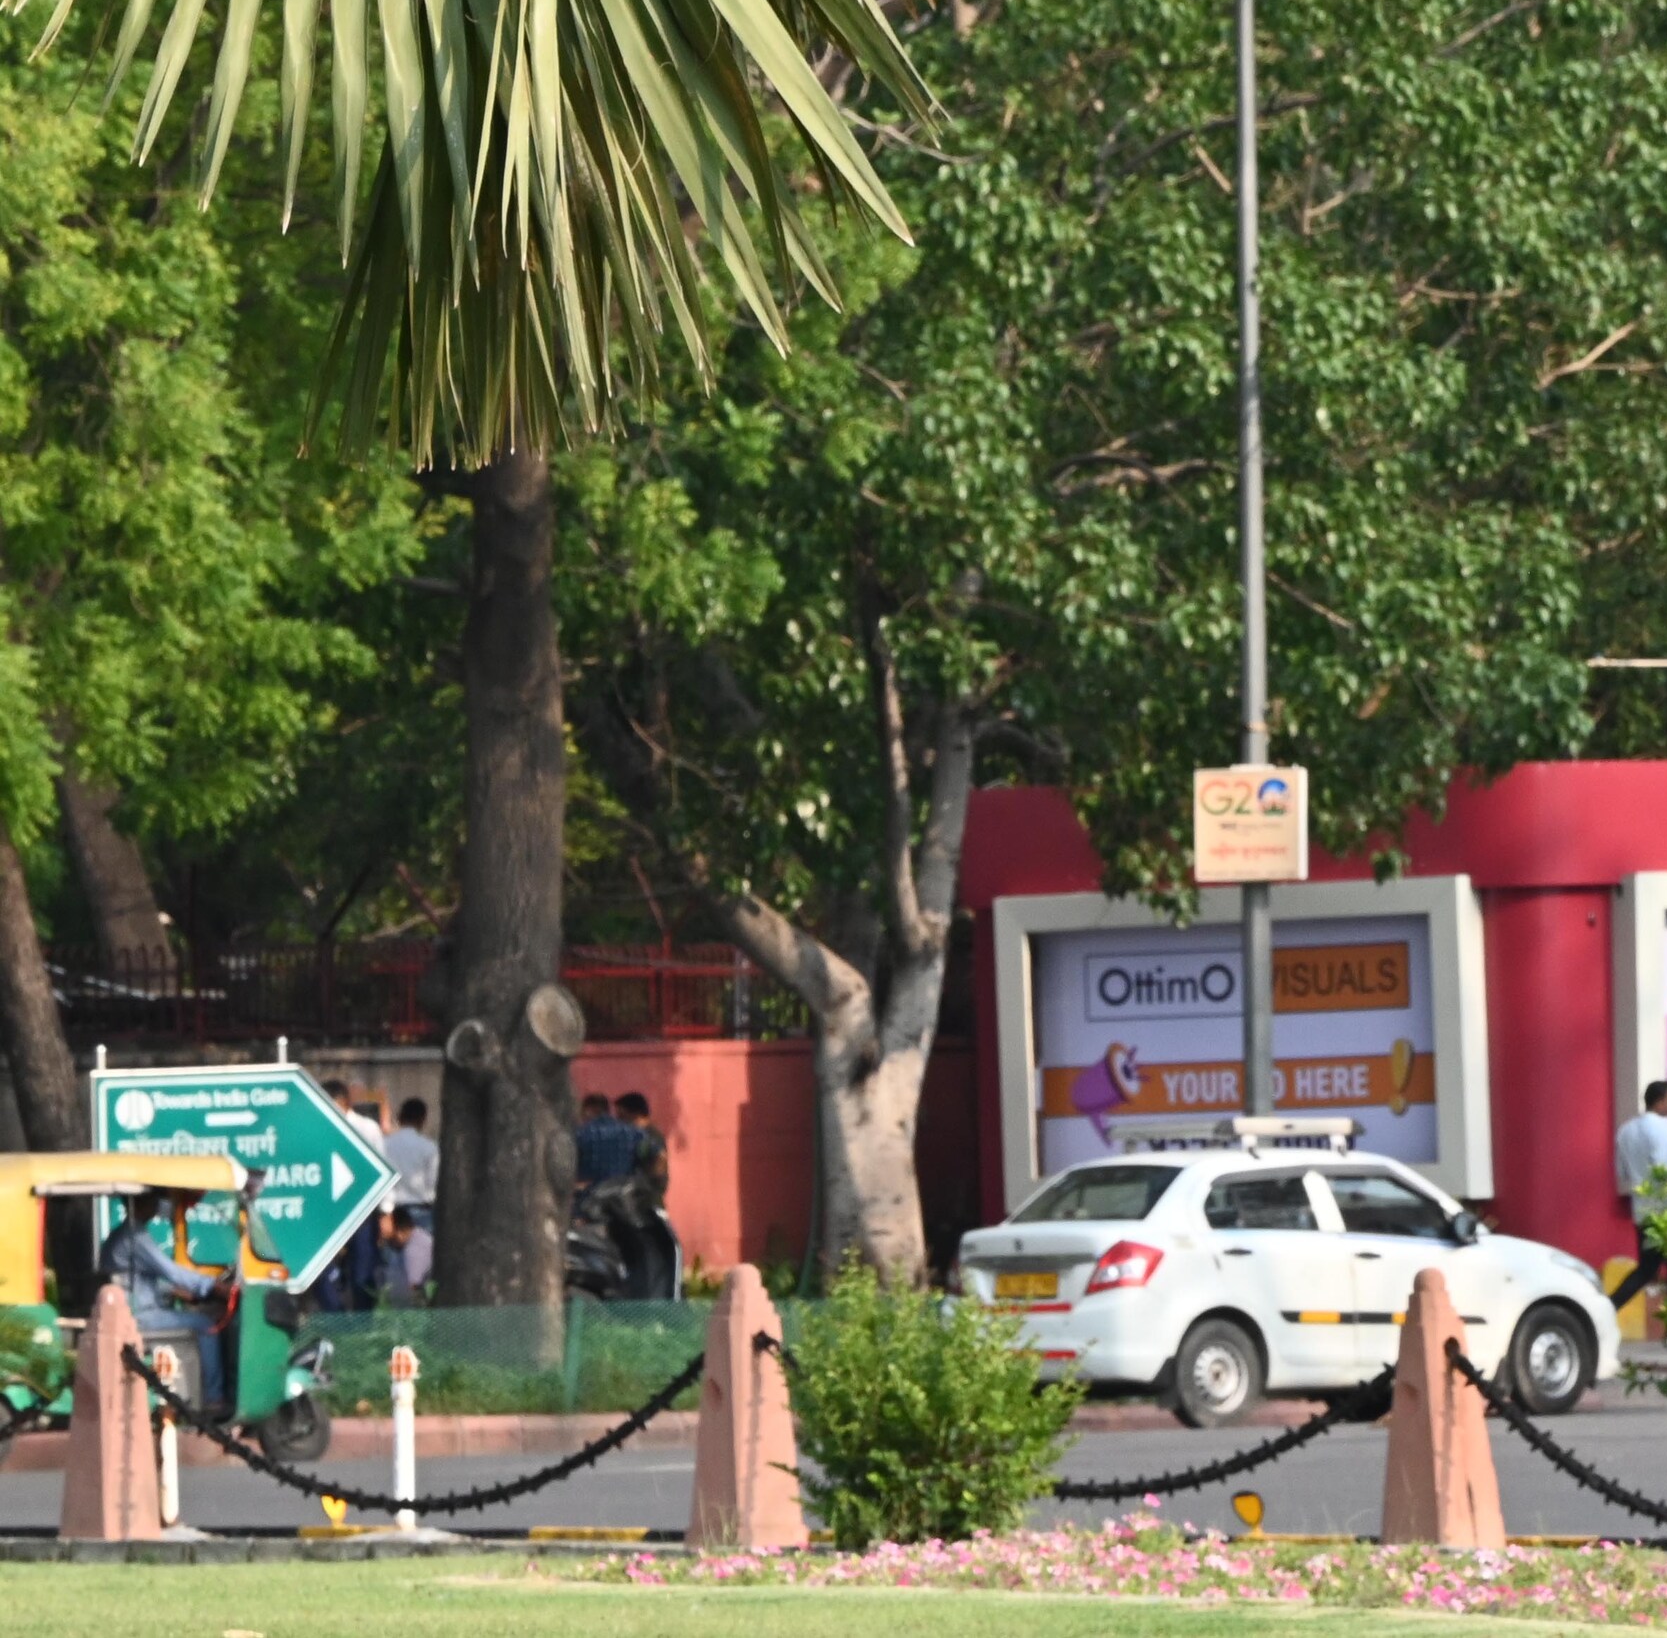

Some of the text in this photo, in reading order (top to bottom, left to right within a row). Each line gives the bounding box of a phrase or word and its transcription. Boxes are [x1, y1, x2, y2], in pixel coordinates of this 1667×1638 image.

[1098, 963, 1236, 1007] OttimO
[213, 1088, 249, 1108] India
[250, 1087, 289, 1106] Gate
[1161, 1070, 1240, 1104] YOUR
[1292, 1064, 1371, 1100] HERE
